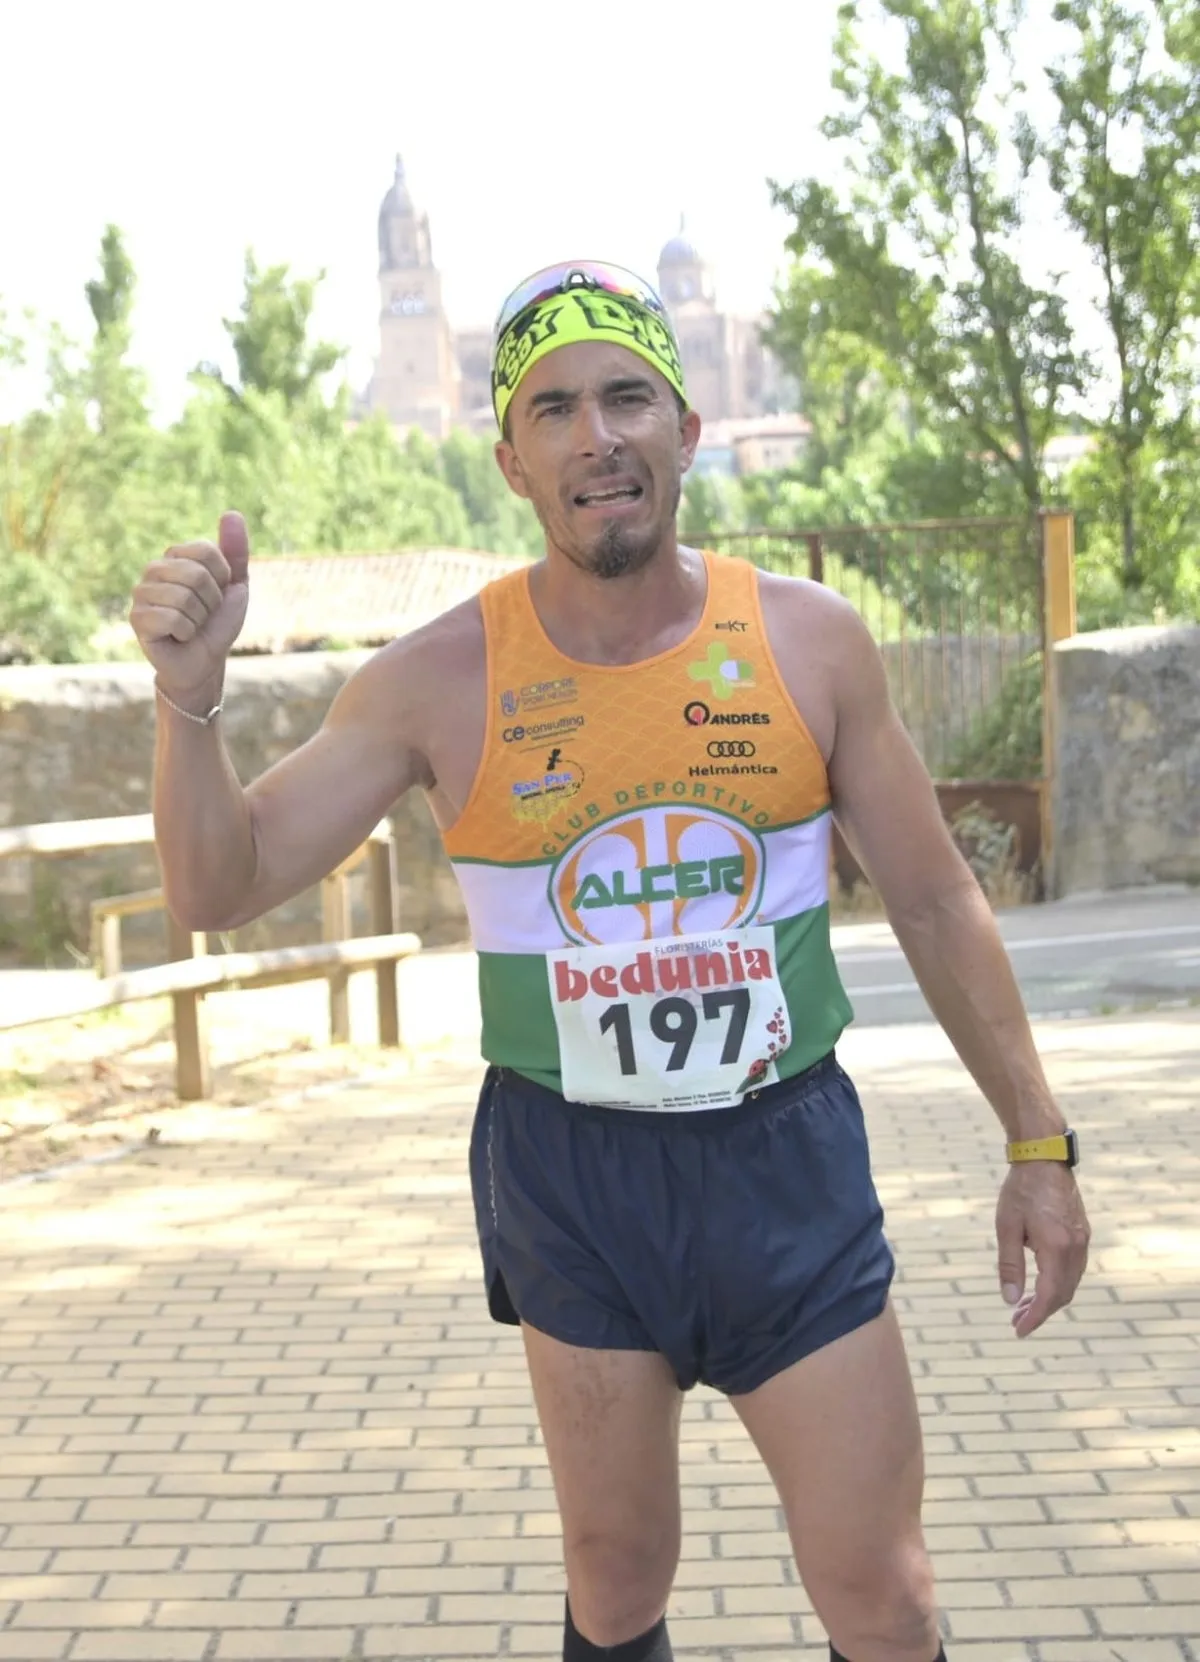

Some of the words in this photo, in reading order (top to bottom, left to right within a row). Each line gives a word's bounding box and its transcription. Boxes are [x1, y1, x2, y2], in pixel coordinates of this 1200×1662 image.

[688, 764, 778, 777] Helmántica
[541, 803, 601, 857] CLUB
[614, 780, 769, 826] DEPORTIVO
[570, 853, 746, 911] ALCER
[553, 941, 774, 1003] bedunia
[655, 938, 723, 956] FLORISTERÍAS
[599, 987, 751, 1076] 197
